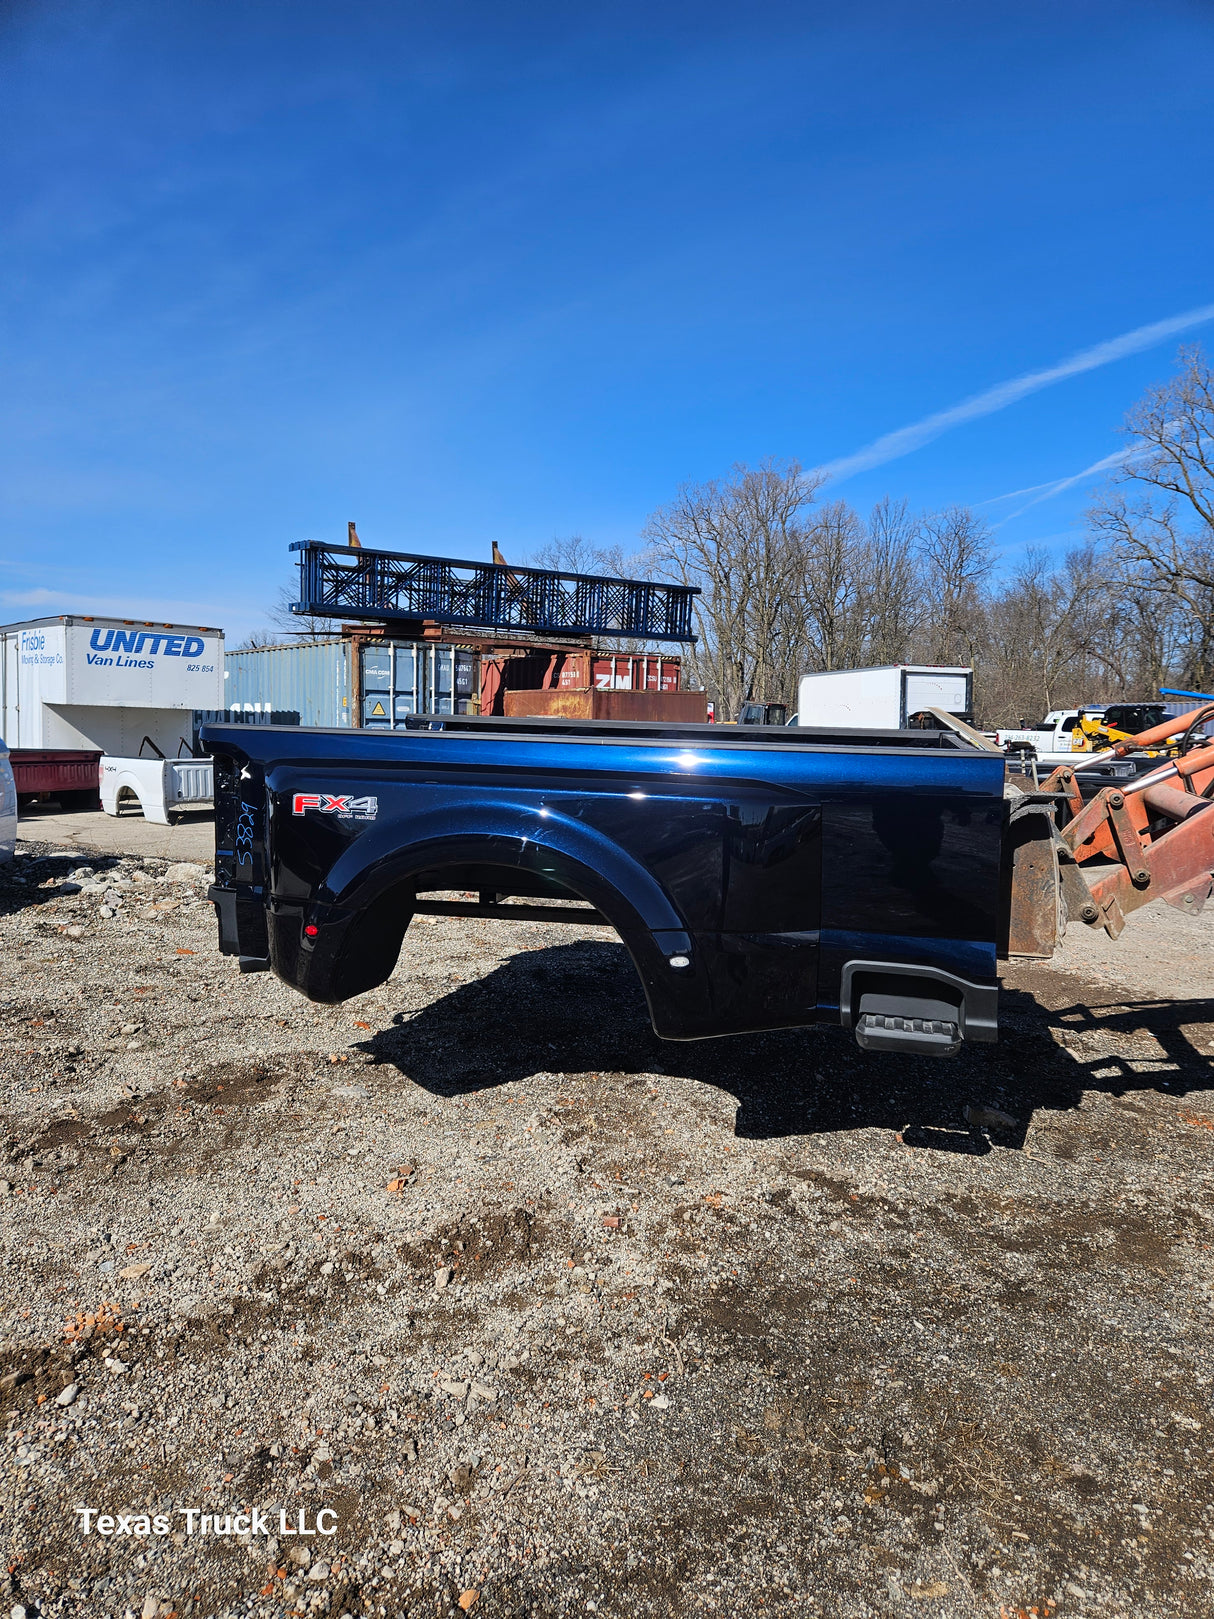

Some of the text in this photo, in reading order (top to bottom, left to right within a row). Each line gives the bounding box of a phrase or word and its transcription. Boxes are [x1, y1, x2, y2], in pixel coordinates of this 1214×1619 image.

[22, 630, 45, 651] Frisbie
[90, 629, 205, 658] UNITED
[34, 653, 40, 664] &
[86, 653, 155, 669] Van Lines
[186, 664, 200, 672] 825
[595, 674, 631, 689] ZIM
[292, 793, 378, 816] FX4
